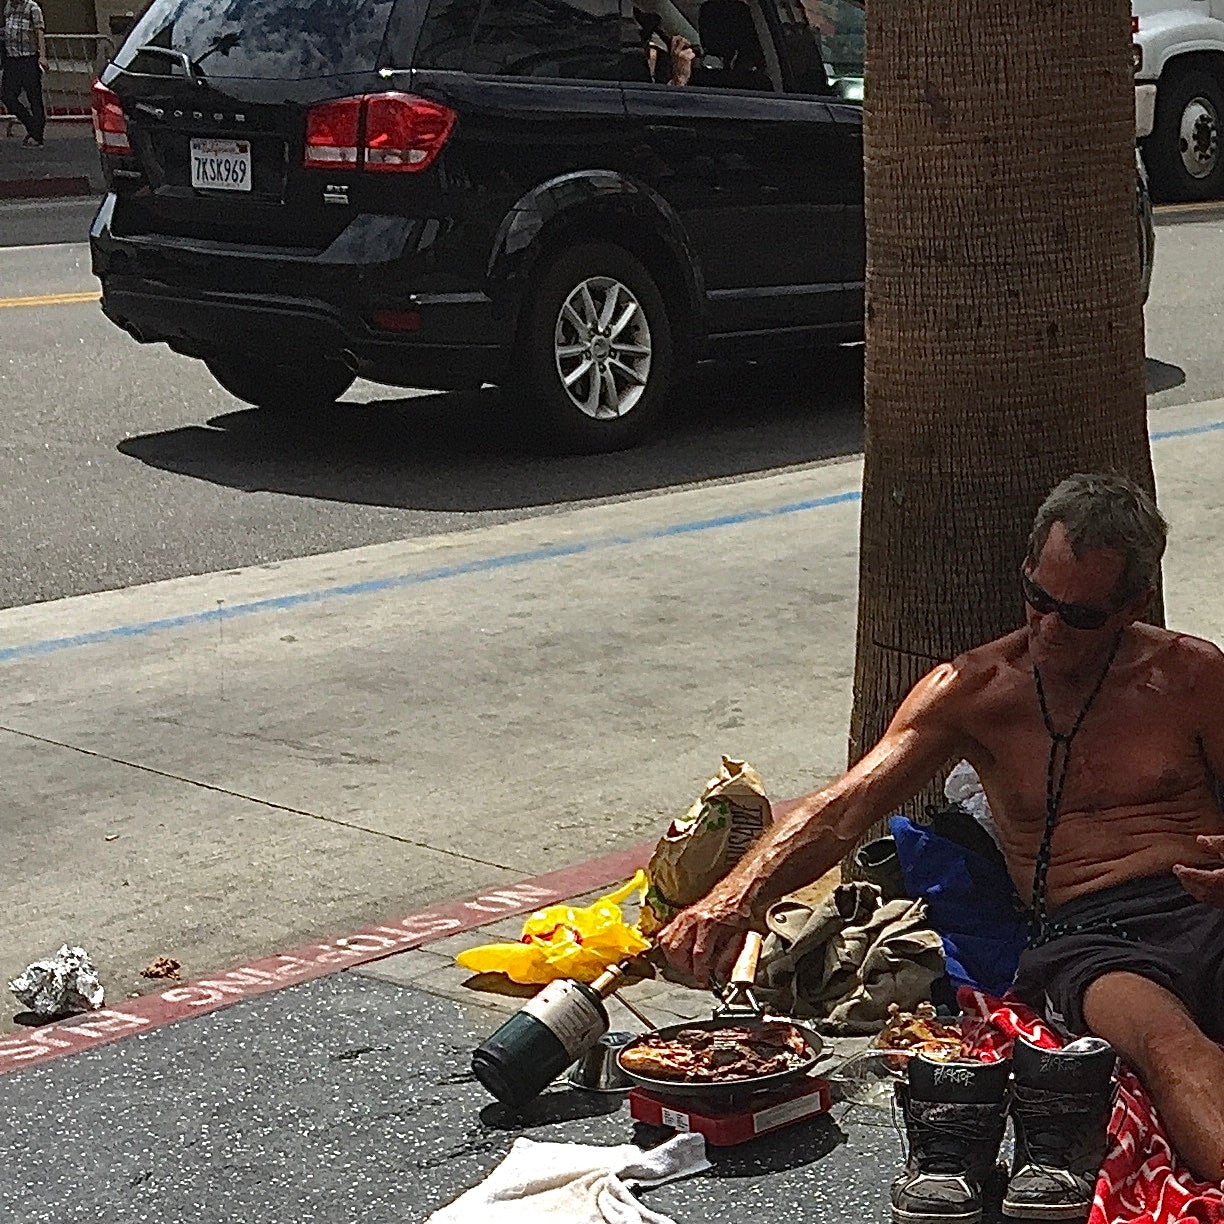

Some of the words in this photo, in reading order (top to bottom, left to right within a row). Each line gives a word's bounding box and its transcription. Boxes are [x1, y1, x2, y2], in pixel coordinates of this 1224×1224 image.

[194, 157, 247, 183] 7KSK969
[464, 882, 560, 913] NO
[161, 912, 461, 1008] STOPPING
